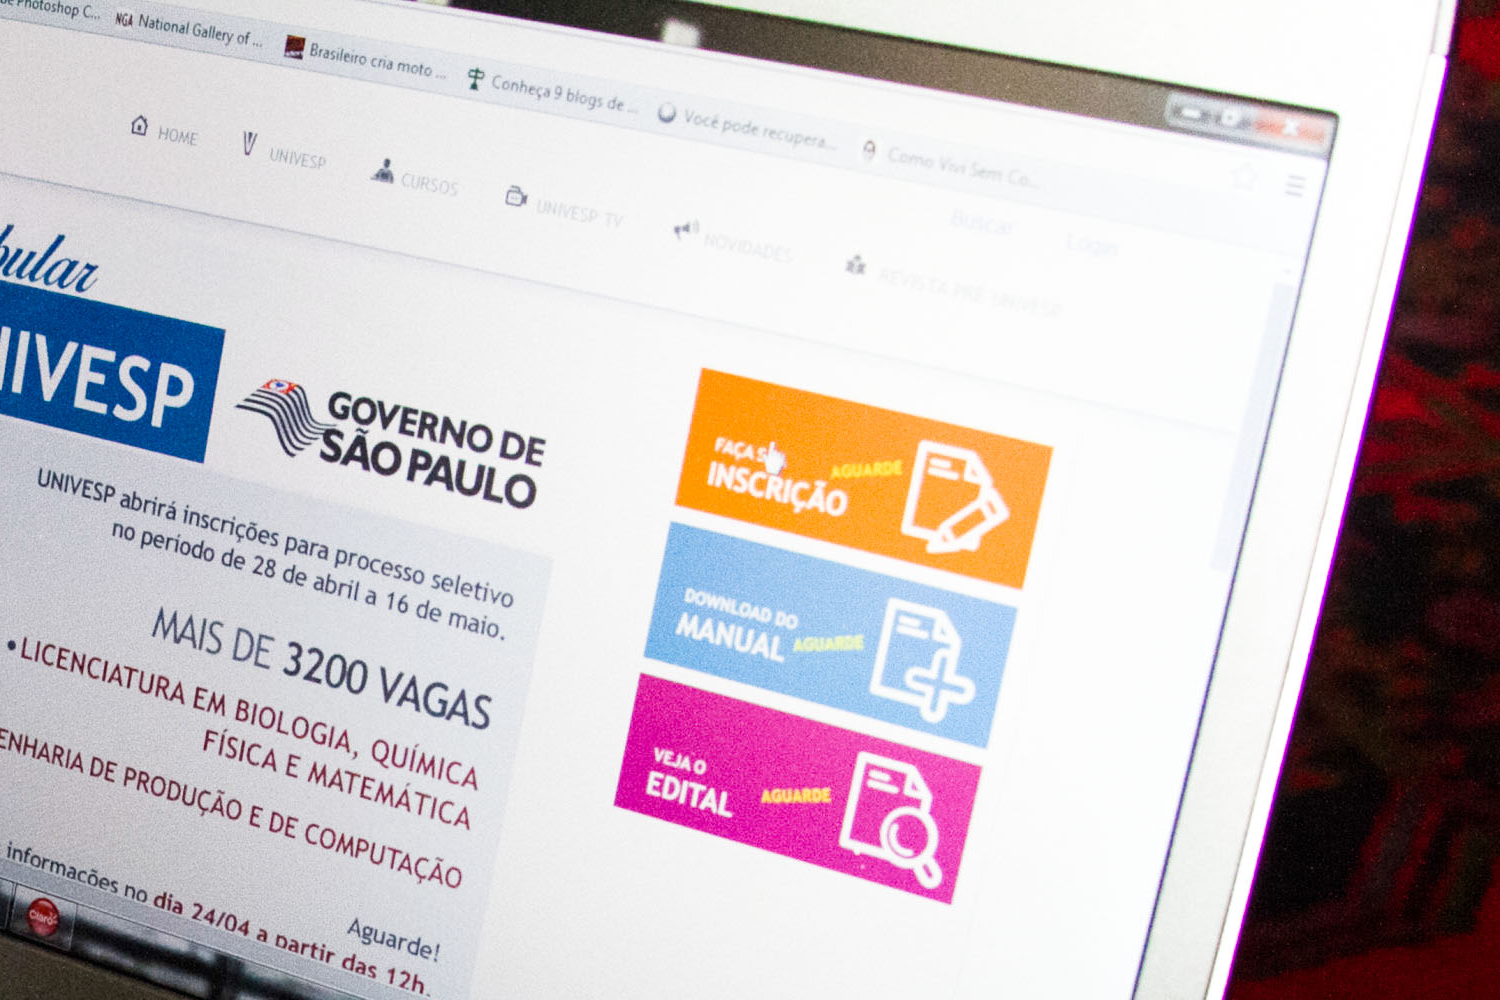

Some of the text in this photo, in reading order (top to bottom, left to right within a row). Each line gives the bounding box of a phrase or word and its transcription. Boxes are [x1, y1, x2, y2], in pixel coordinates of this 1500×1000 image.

[138, 13, 251, 46] National Gallery of
[309, 43, 433, 78] Brasileiro cria moto
[492, 75, 625, 112] Conheça 9 blogs de
[158, 125, 198, 147] HOME
[684, 108, 719, 130] Você
[721, 119, 760, 137] pode
[269, 147, 327, 171] UNIVESP
[401, 172, 460, 197] CURSOS
[536, 199, 624, 230] UNIVESP TV
[328, 390, 547, 467] GOVERNO DE
[714, 437, 755, 461] FAÇA
[318, 423, 538, 510] SÃO PAULO
[707, 461, 849, 518] INSCRIÇÃO
[829, 458, 903, 481] AGUARDE
[37, 467, 515, 610] UNIVESP abrirá inscrições para processo seletivo
[112, 520, 507, 642] no período de 28 de abril a 16 de maio.
[684, 587, 799, 631] DOWNLOAD DO
[675, 612, 865, 663] MANUAL AGUARDE
[151, 605, 493, 731] MAIS DE 3200 VAGAS
[21, 637, 479, 792] LICENCIATURA EM BIOLOGIA, QUÍMICA
[202, 728, 472, 831] FÍSICA E MATEMÁTICA
[652, 747, 708, 775] VEJA O
[645, 770, 832, 819] EDITAL AGUARDE
[90, 755, 118, 784] DE
[123, 768, 243, 822] PRODUÇÃO
[249, 806, 263, 829] E
[269, 811, 299, 840] DE
[304, 822, 464, 890] COMPUTAÇÃO
[29, 909, 55, 926] Claro
[124, 882, 148, 904] no
[153, 891, 185, 916] dia
[191, 902, 251, 938] 24/04
[256, 926, 269, 943] a
[341, 953, 378, 979] das
[387, 967, 431, 998] 12h.
[346, 917, 443, 964] Aguarde!
